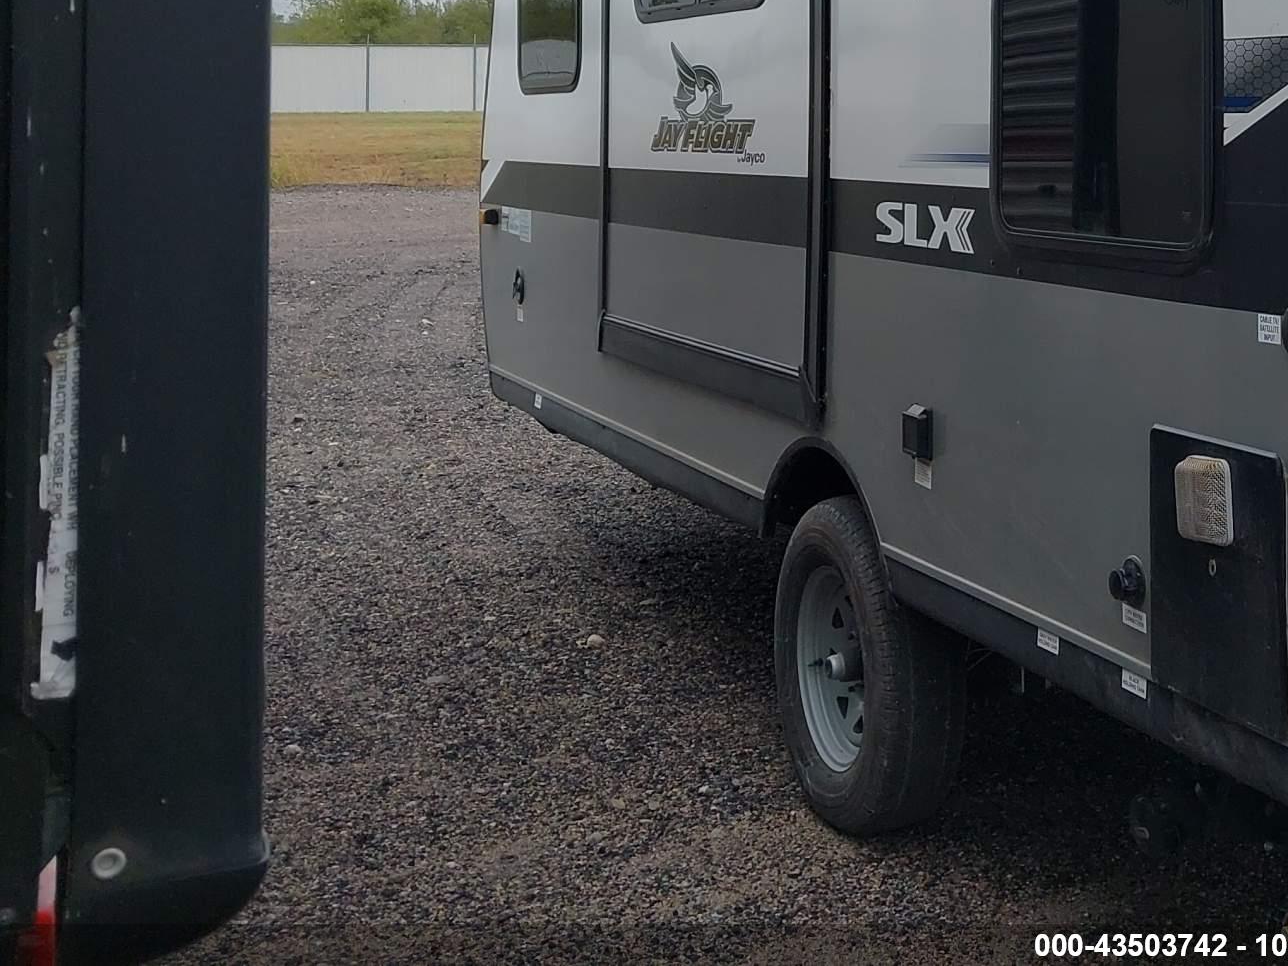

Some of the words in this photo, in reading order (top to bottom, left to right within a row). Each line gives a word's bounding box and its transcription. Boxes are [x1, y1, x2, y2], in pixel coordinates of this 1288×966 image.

[651, 116, 684, 152] JAY
[681, 119, 755, 154] FLIGHT
[741, 149, 765, 166] Jayco
[875, 201, 976, 254] SLX
[52, 432, 65, 490] POSSIBLE
[63, 551, 78, 618] DEPLOYING
